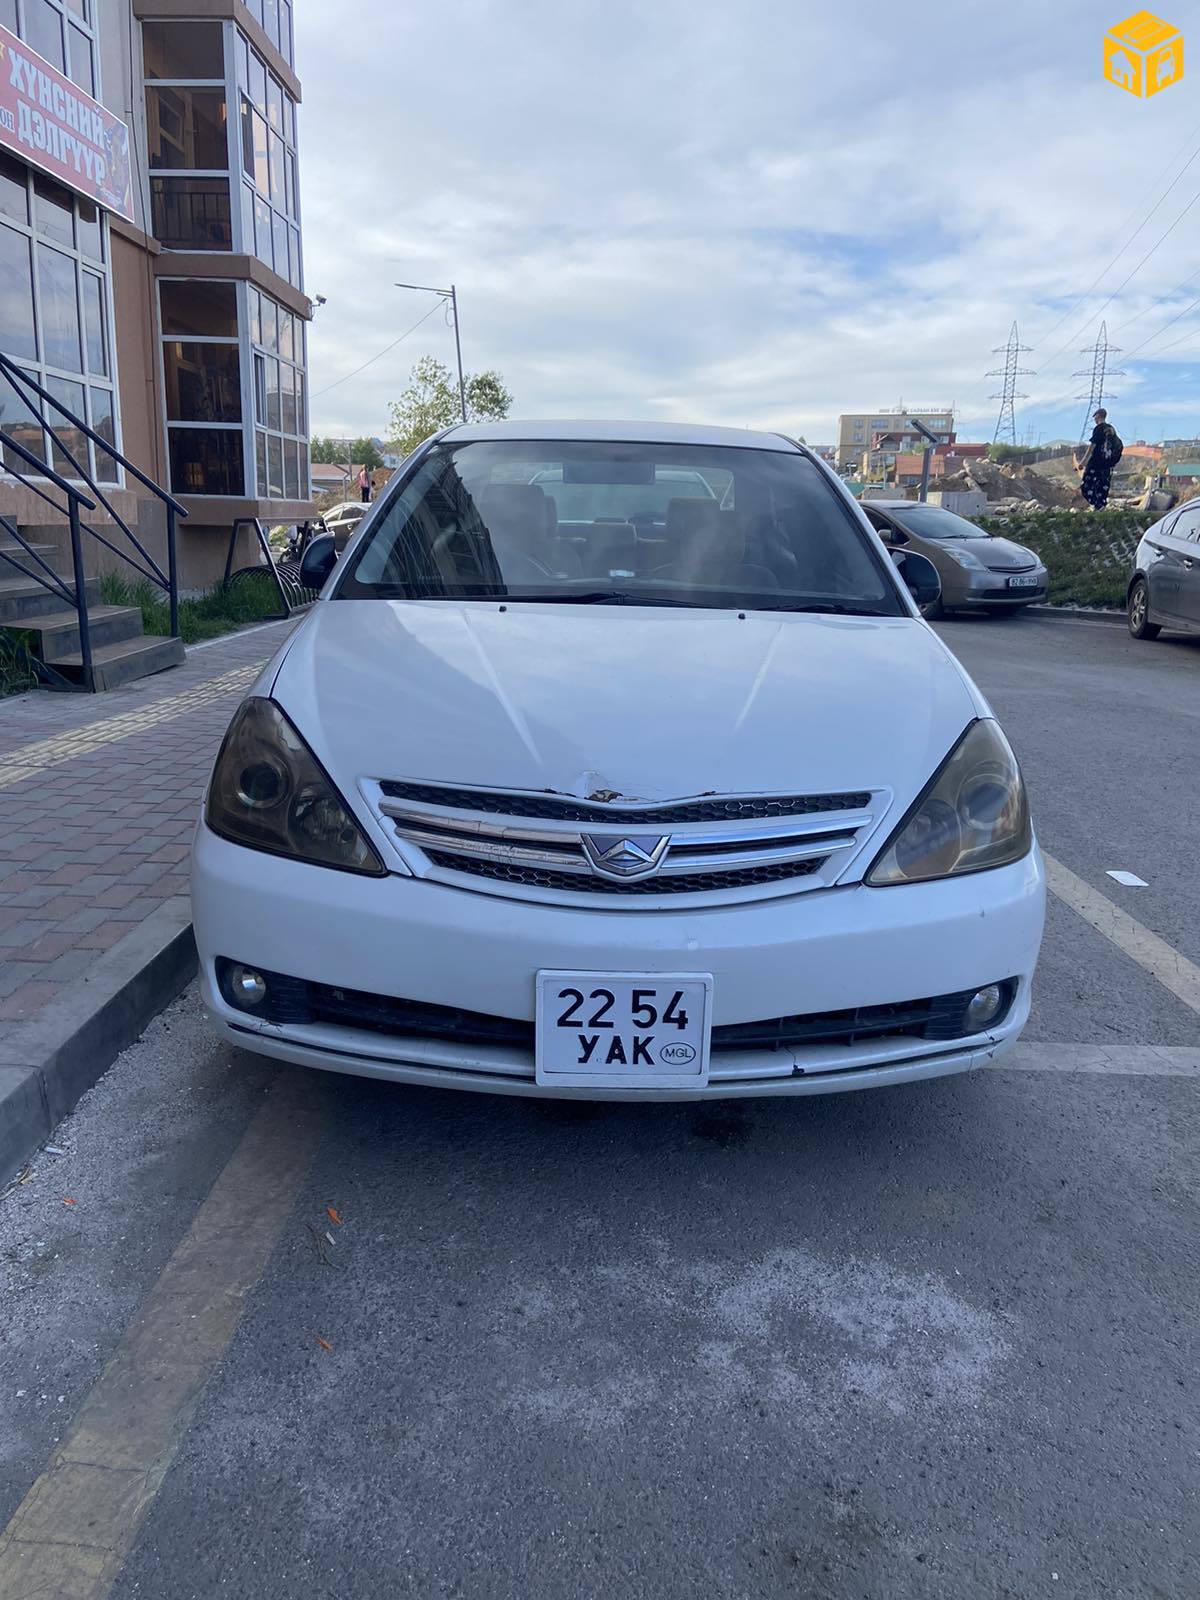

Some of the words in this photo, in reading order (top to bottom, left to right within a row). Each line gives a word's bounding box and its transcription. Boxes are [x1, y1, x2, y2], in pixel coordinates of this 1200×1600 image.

[8, 47, 105, 150] ХҮНСНИЙ
[17, 99, 106, 187] ДЭЛГҮҮР
[577, 1034, 656, 1065] УАК
[664, 1048, 692, 1059] MGL
